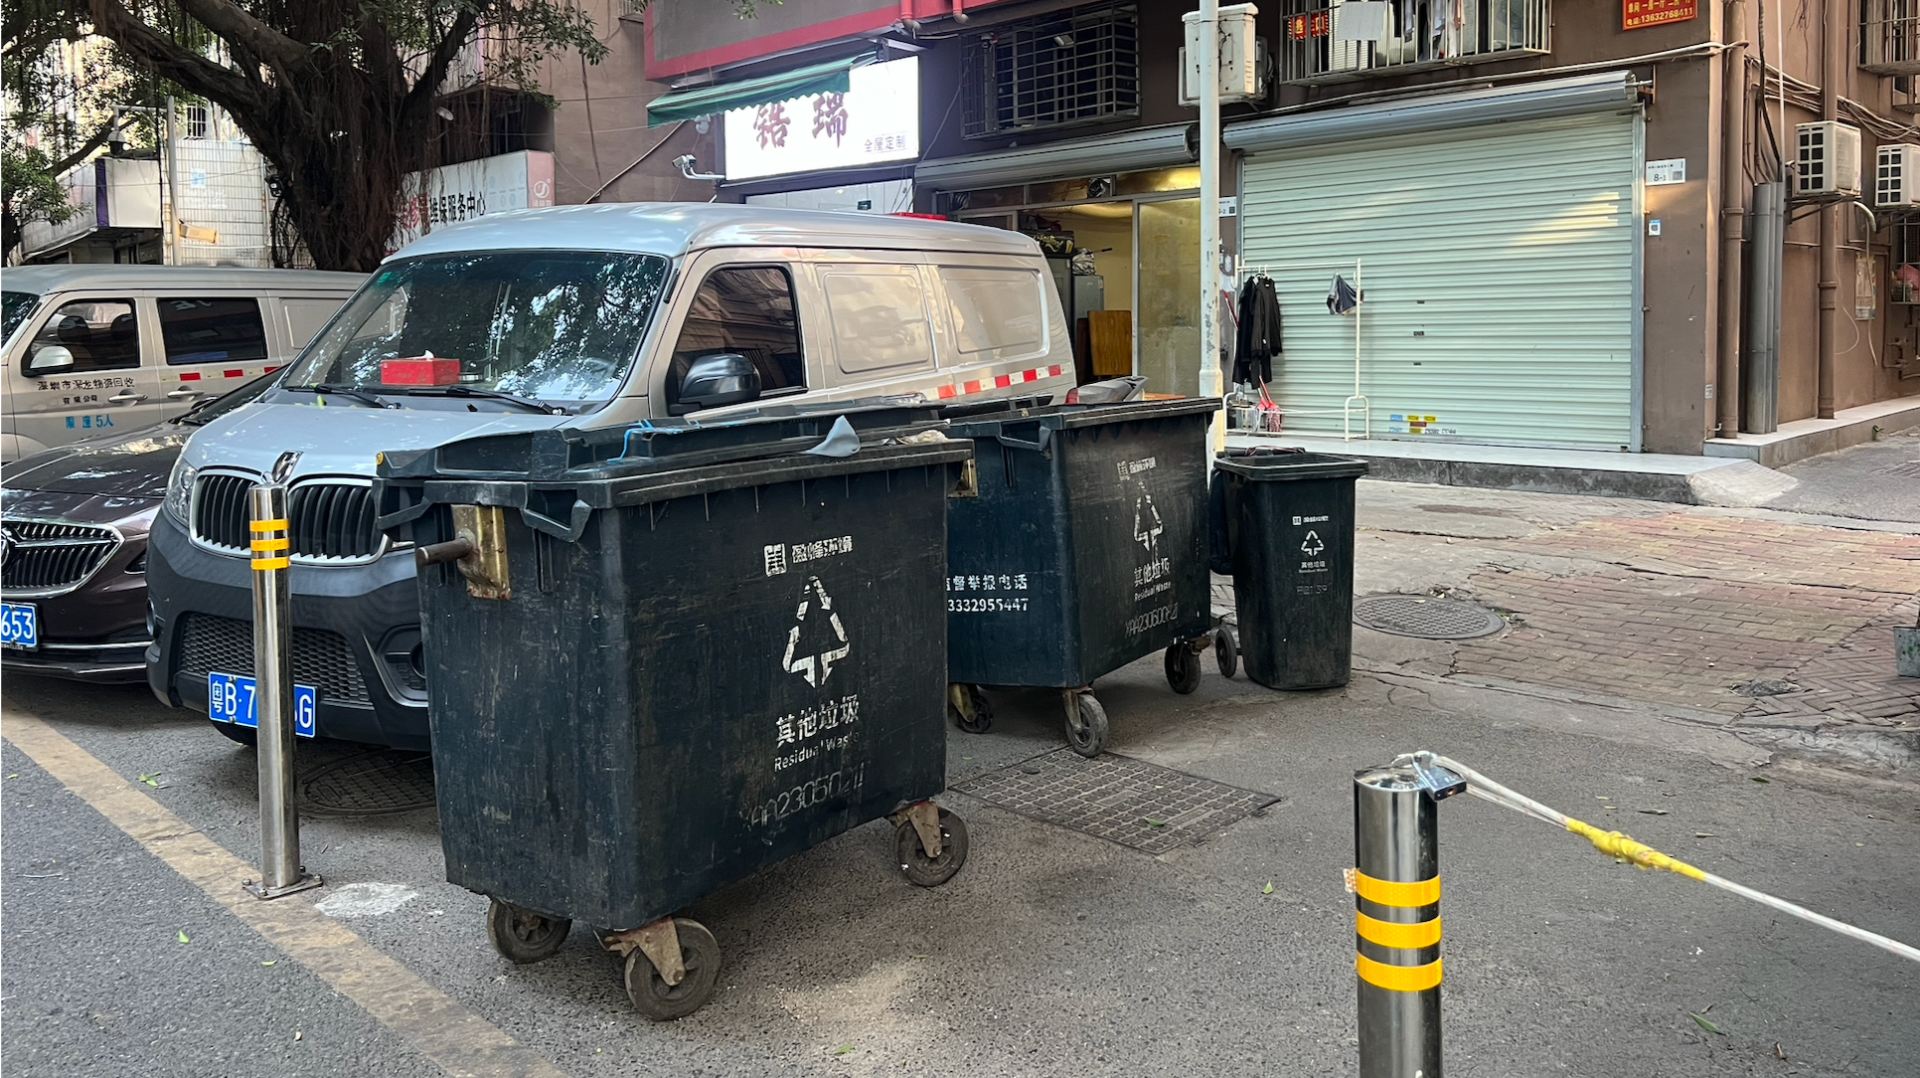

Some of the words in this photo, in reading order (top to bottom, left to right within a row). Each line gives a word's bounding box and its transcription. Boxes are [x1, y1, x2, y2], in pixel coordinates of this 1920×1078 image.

[864, 134, 907, 153] 全屋定制
[1, 610, 34, 639] 653
[776, 694, 859, 749] 其他垃圾
